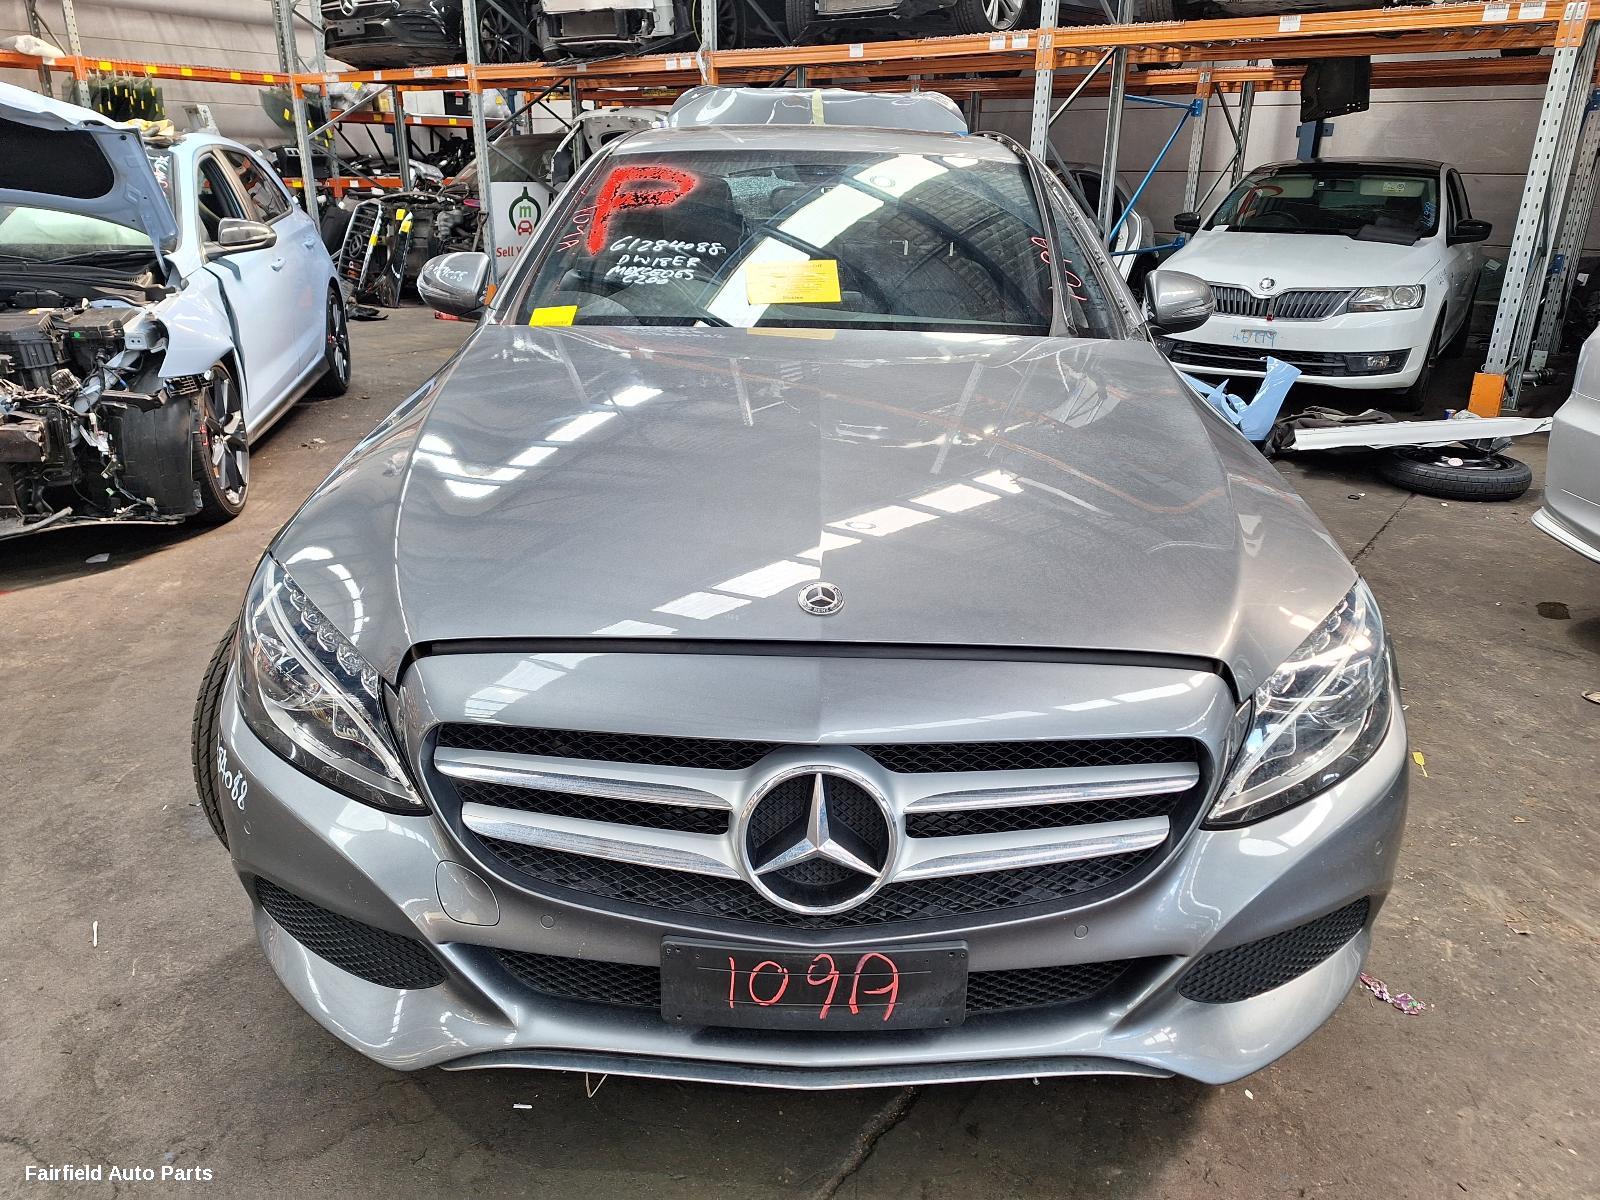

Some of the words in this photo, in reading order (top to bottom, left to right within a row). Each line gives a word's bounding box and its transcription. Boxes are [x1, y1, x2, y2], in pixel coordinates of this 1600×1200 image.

[519, 206, 532, 217] m
[587, 165, 697, 256] P
[496, 246, 514, 257] Sell
[610, 236, 727, 255] 61284088
[622, 274, 669, 285] C200
[728, 952, 899, 1022] 109A
